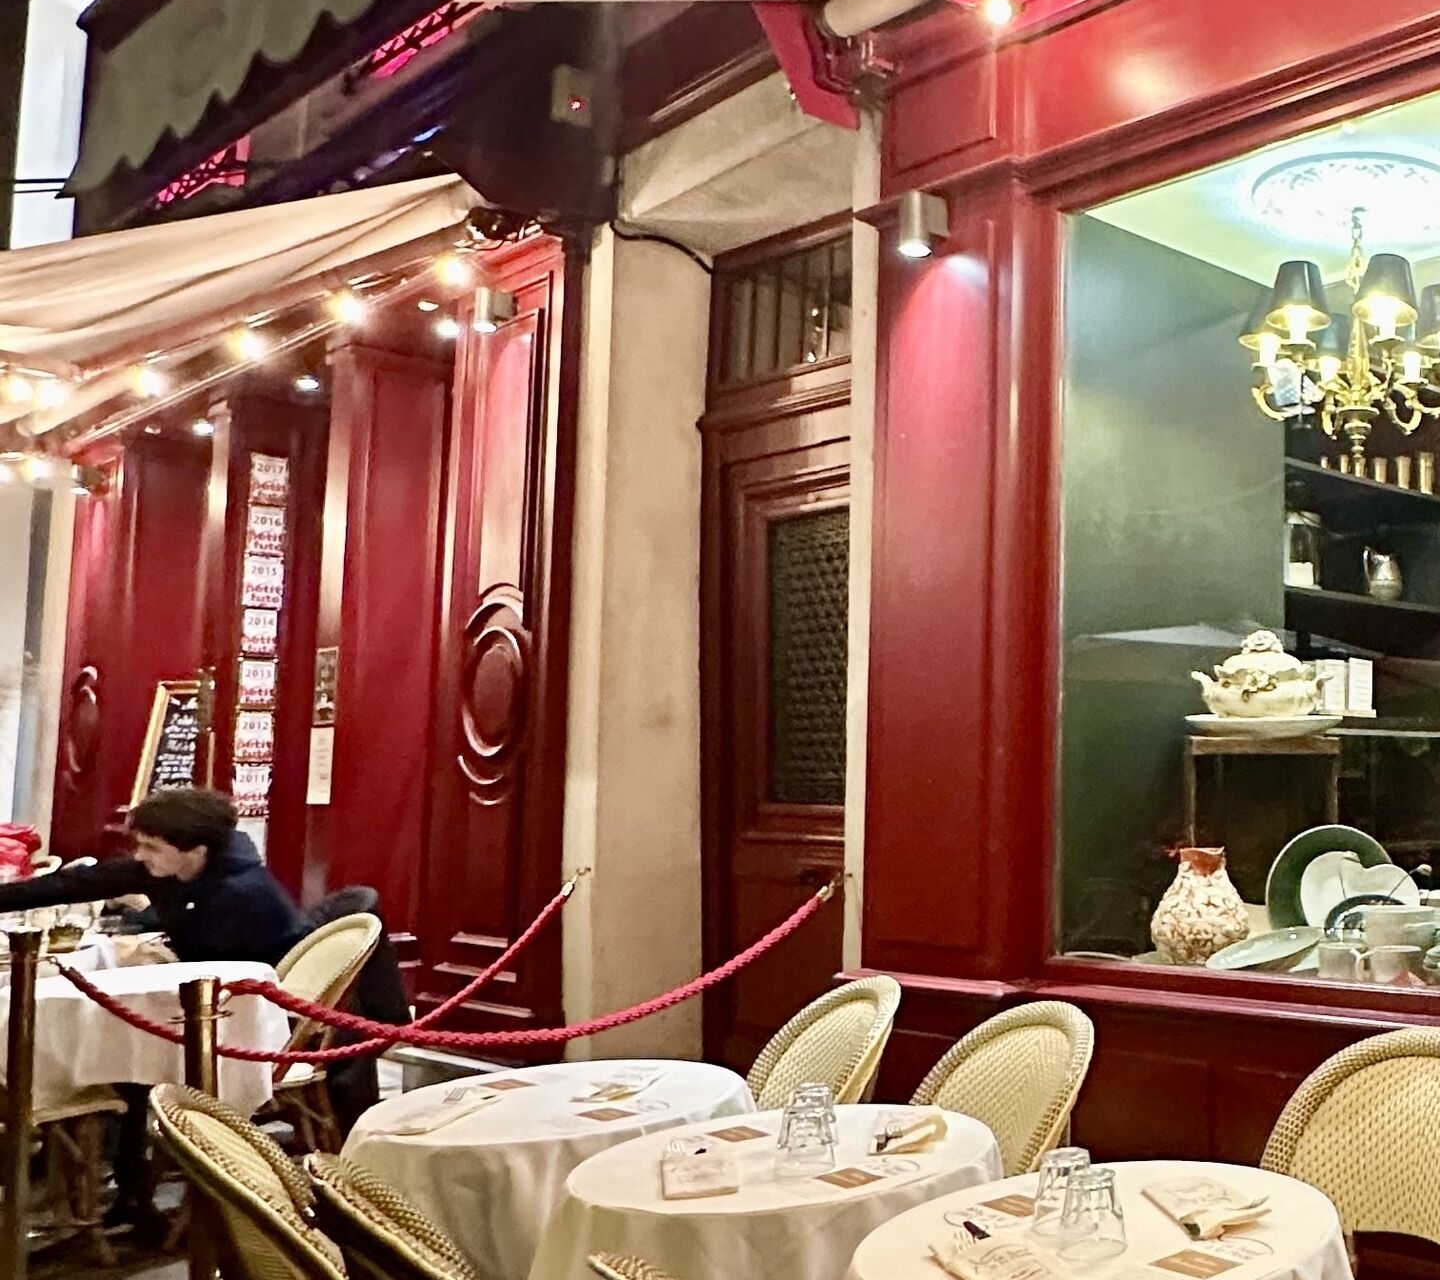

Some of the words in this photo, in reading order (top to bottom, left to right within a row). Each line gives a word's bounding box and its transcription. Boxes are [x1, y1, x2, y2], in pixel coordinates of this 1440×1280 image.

[257, 463, 284, 474] 2017
[253, 515, 281, 527] 2016
[251, 566, 277, 576] 2015
[248, 617, 274, 626] 2014
[245, 669, 271, 679] 2013
[242, 721, 268, 730] 2012
[239, 774, 265, 783] 2011
